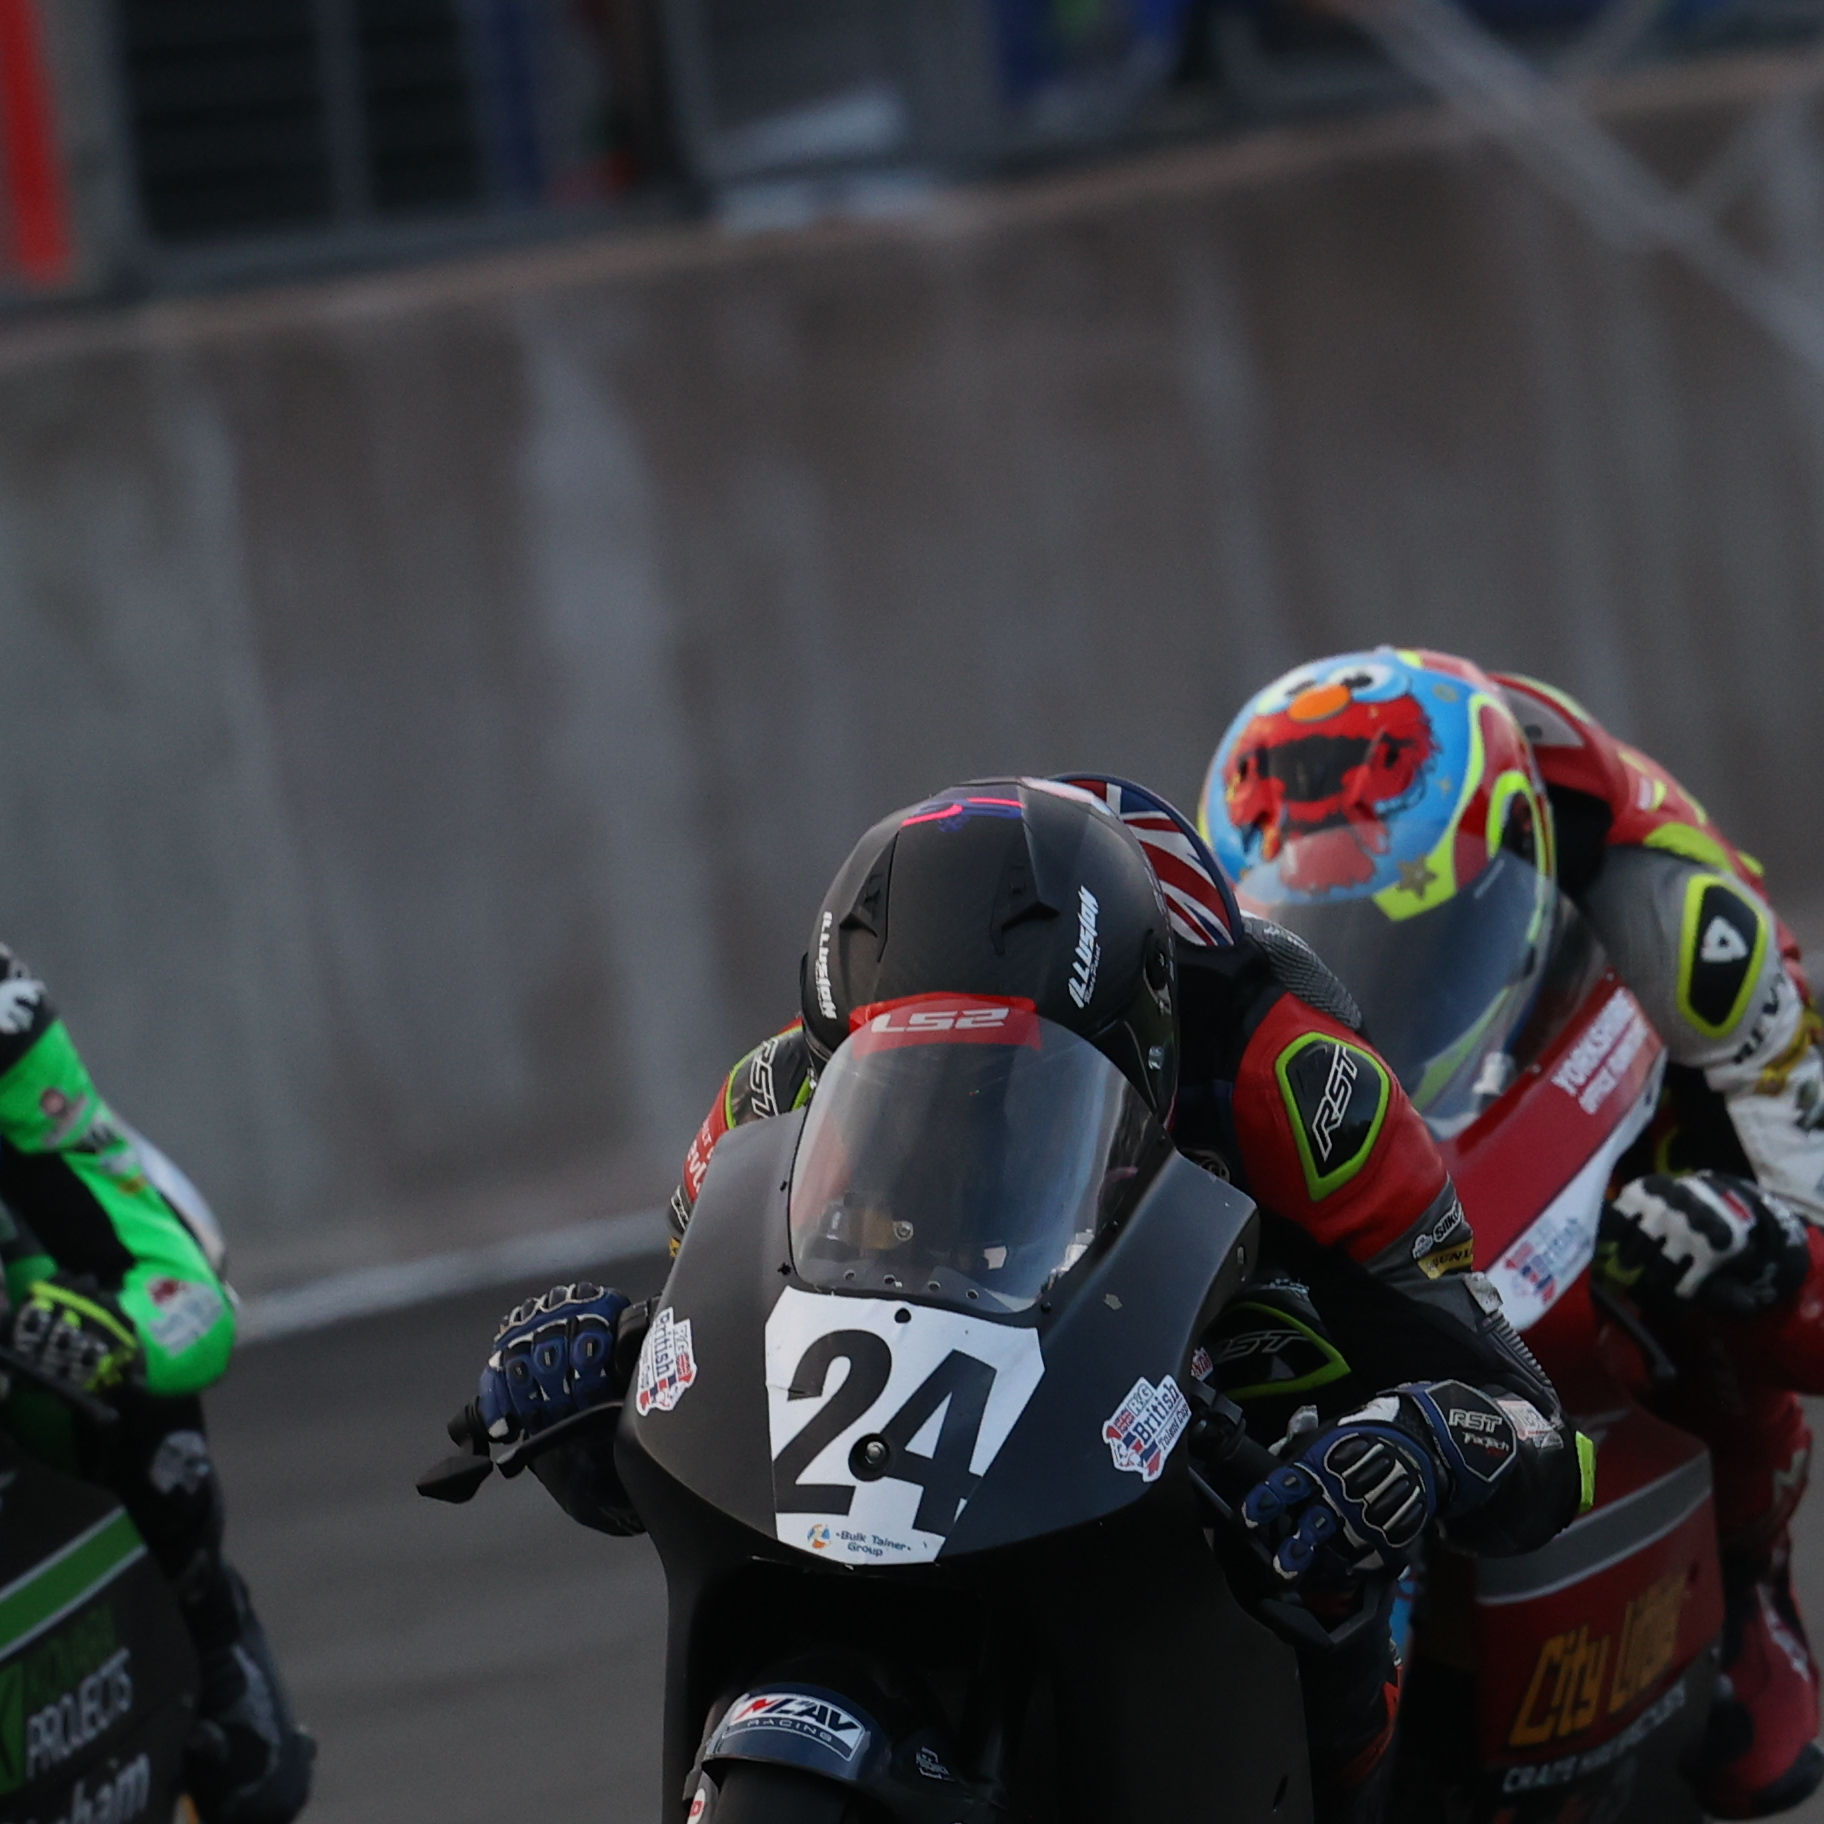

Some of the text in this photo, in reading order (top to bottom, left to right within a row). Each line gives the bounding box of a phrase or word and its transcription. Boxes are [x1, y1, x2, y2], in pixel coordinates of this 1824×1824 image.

[871, 1008, 1009, 1032] LS2
[1312, 1044, 1358, 1163] RST
[1132, 1382, 1181, 1444] British
[1448, 1408, 1503, 1433] RST
[772, 1329, 998, 1538] 24
[847, 1541, 883, 1557] Group
[746, 1719, 833, 1743] RACING
